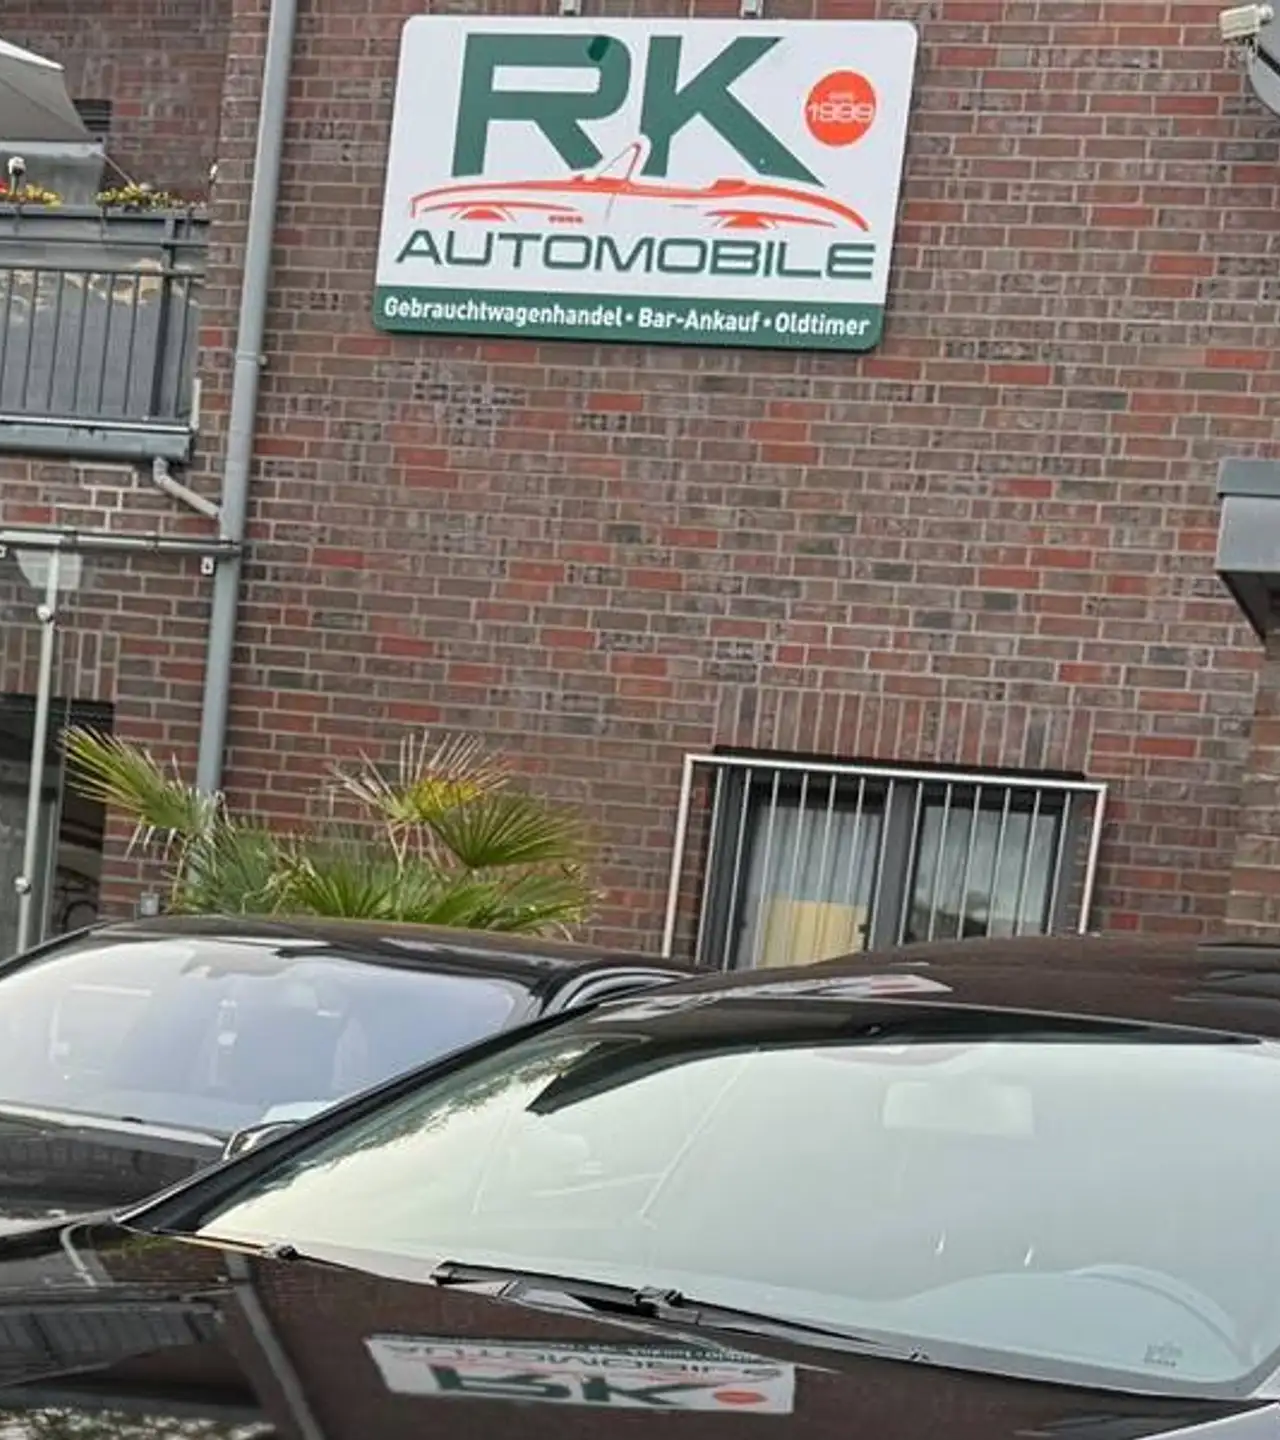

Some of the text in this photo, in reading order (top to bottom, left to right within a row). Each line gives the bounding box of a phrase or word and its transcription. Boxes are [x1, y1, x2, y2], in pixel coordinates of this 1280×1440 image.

[452, 33, 825, 188] RK
[395, 229, 877, 281] AUTOMOBILE
[384, 296, 872, 338] Gebrauchtwagenhandel Bar-Ankauf Oldtimer
